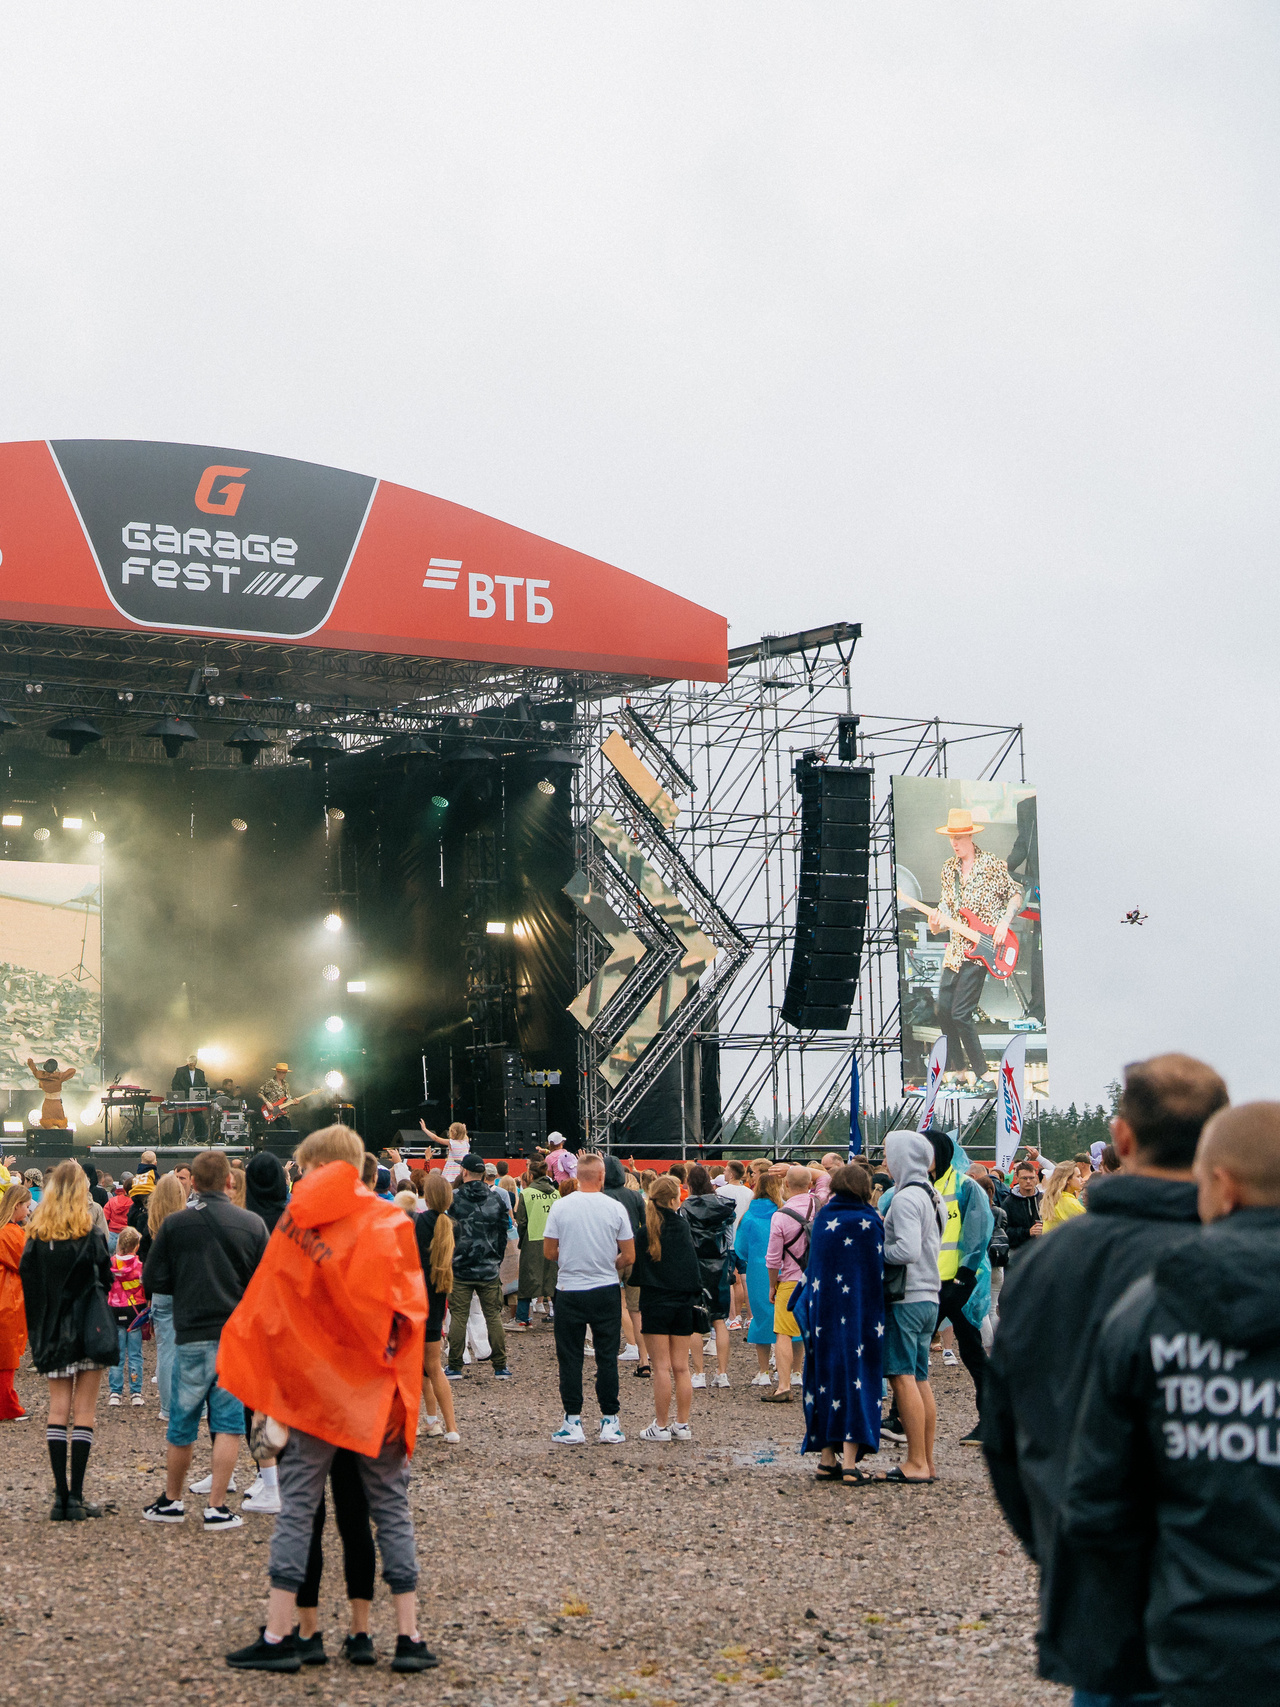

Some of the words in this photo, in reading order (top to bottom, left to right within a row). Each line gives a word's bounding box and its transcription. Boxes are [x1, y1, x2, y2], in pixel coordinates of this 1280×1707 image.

[194, 465, 251, 516] G
[468, 572, 554, 624] ВТБ
[531, 1193, 558, 1201] PHOTO
[1157, 1374, 1280, 1418] ТВОИ
